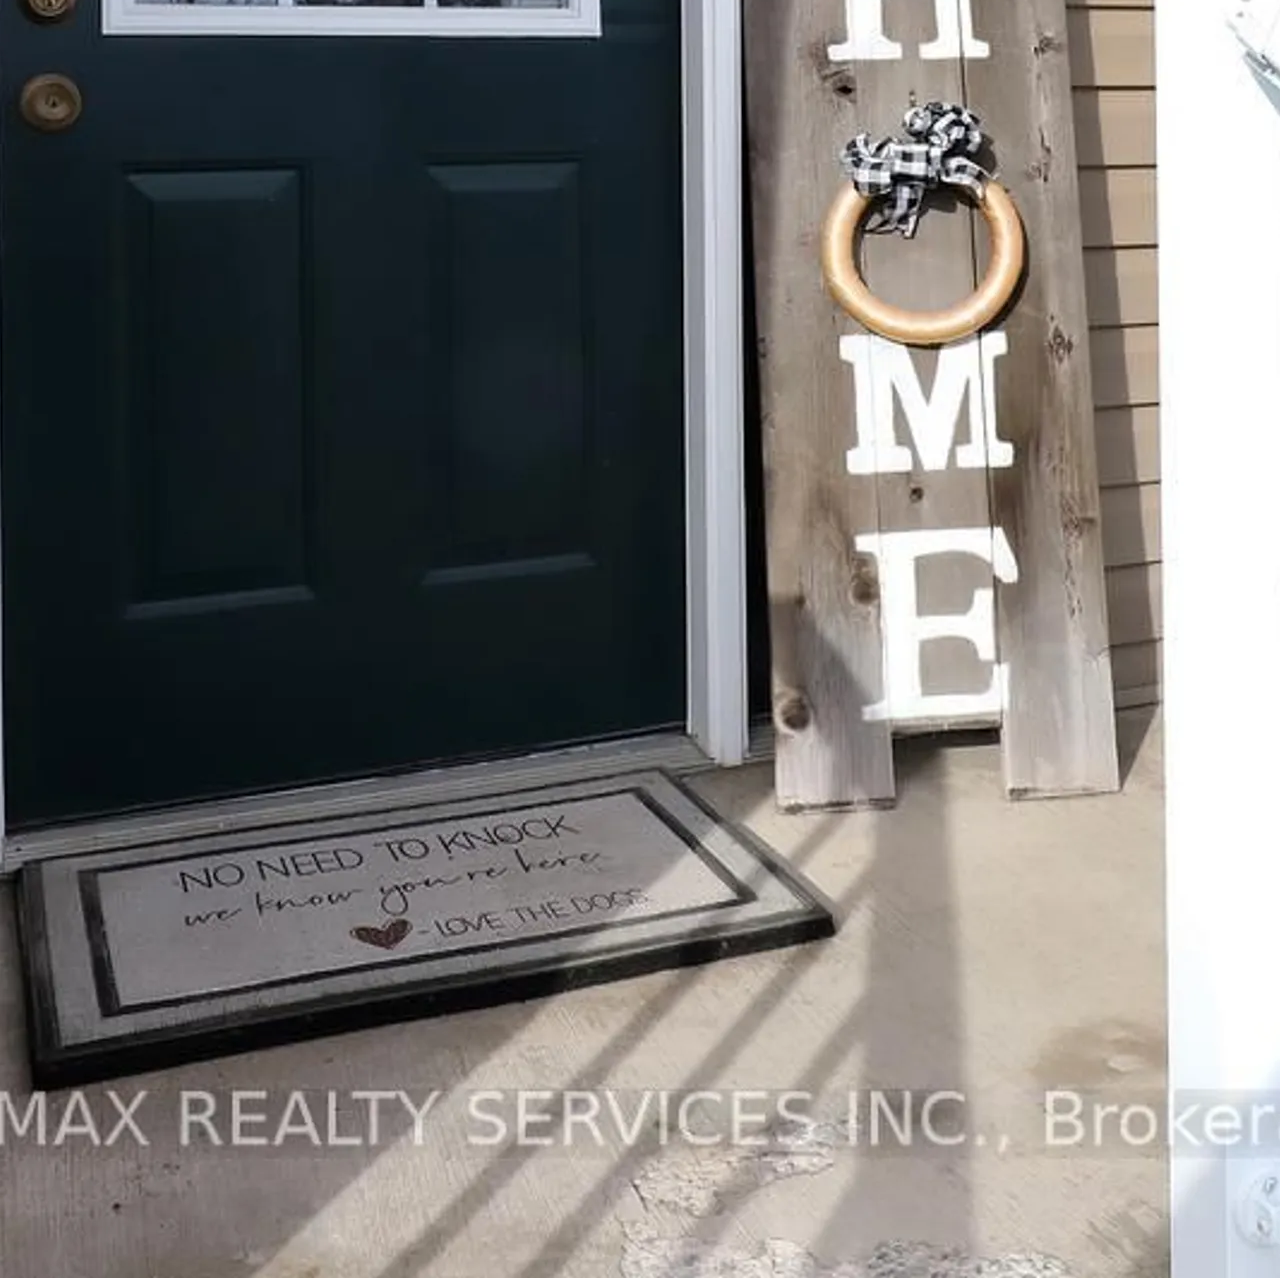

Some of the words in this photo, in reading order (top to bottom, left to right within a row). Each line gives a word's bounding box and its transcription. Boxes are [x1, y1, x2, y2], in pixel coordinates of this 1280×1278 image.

[179, 863, 244, 893] NO
[256, 848, 363, 881] NEED
[373, 838, 429, 861] TO
[438, 815, 580, 854] KNOCK
[183, 908, 242, 926] we
[255, 891, 364, 915] know
[434, 910, 501, 937] LOVE
[508, 901, 571, 923] THE
